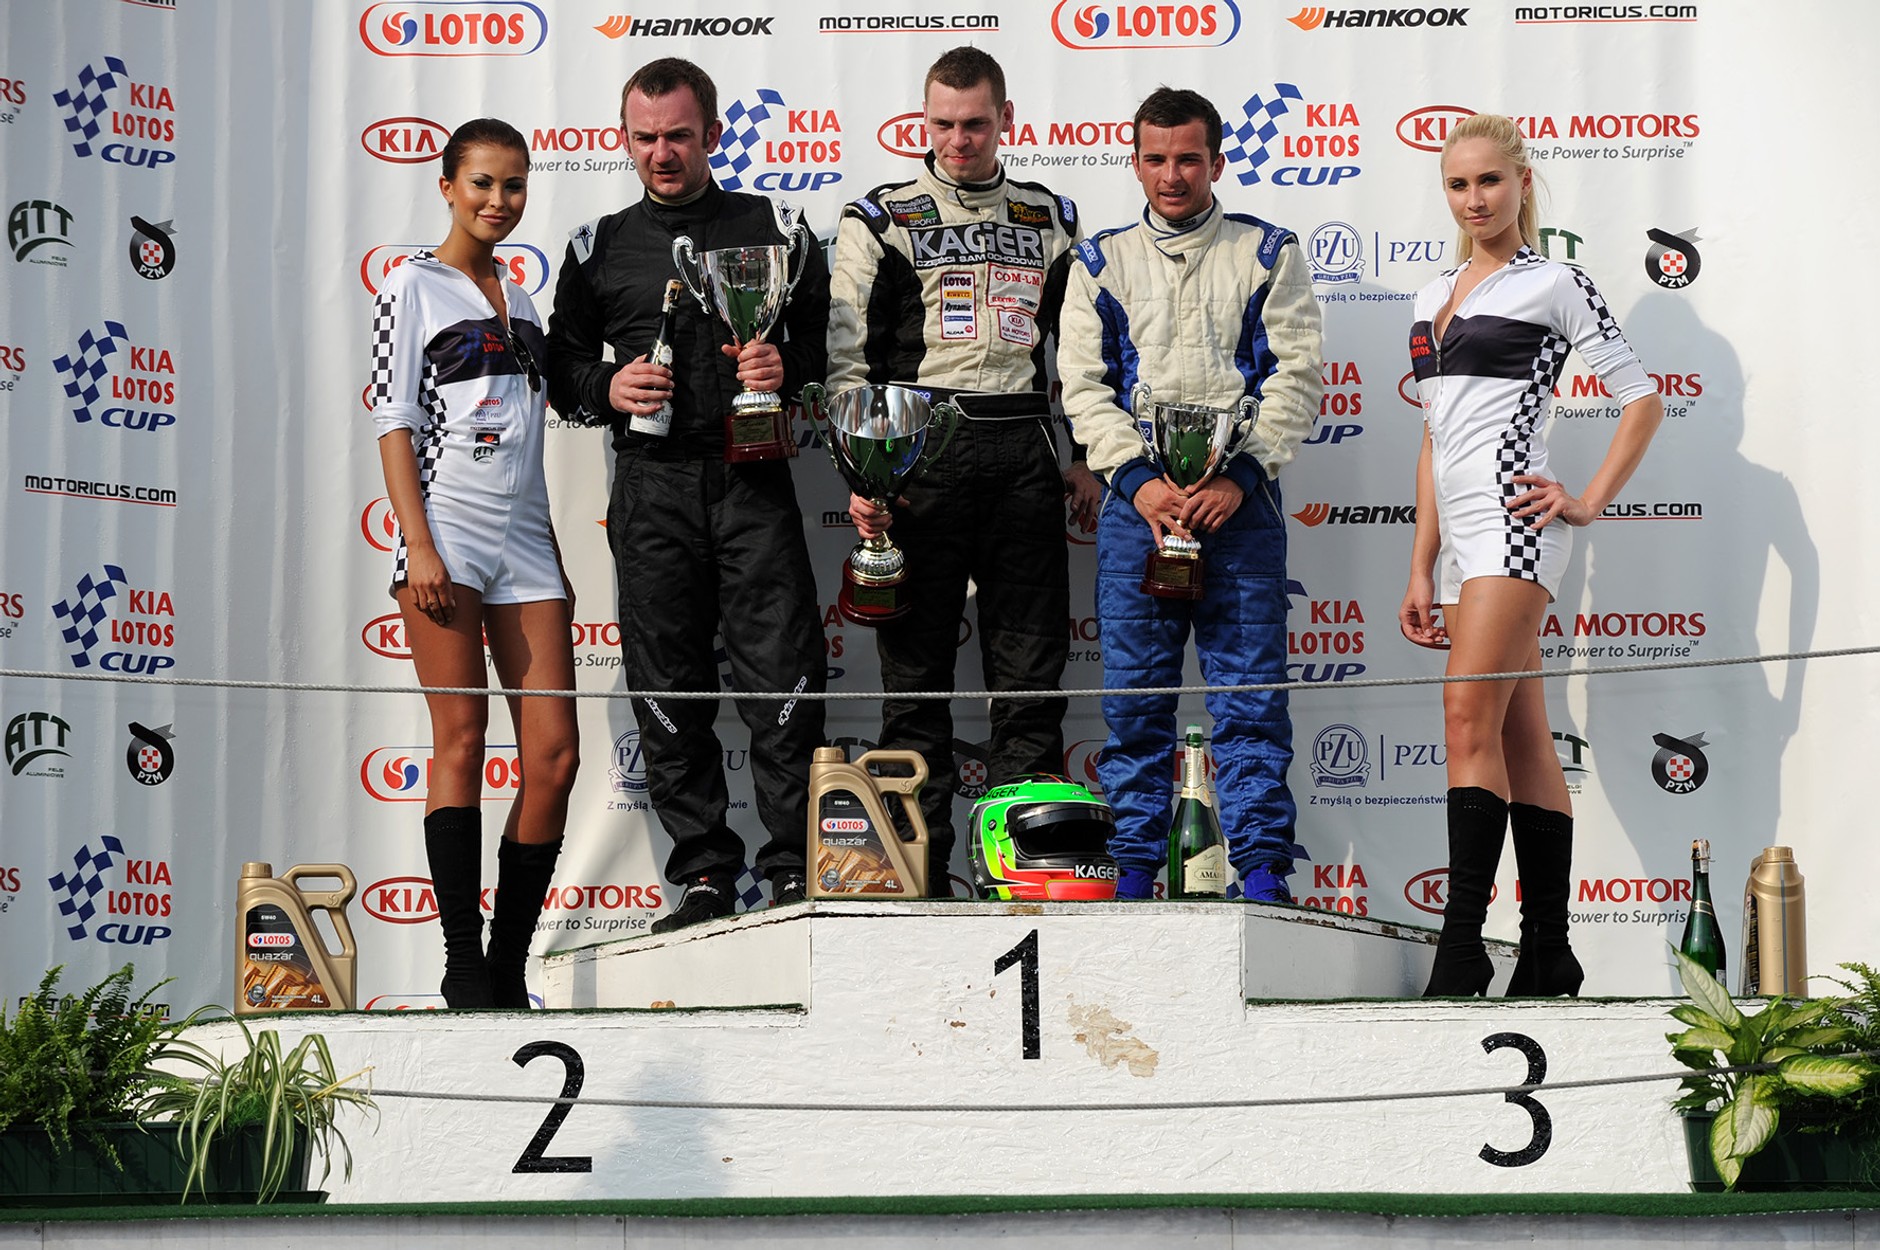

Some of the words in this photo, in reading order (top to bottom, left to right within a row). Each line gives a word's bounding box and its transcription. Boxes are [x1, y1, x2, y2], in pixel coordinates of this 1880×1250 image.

[425, 13, 525, 45] LOTOS
[1117, 5, 1217, 37] LOTOS
[131, 82, 175, 112] KIA
[113, 111, 174, 142] LOTOS
[788, 109, 842, 133] KIA
[1306, 104, 1360, 127] KIA
[1569, 114, 1700, 139] MOTORS
[379, 130, 437, 152] KIA
[532, 127, 622, 151] MOTO
[895, 124, 926, 147] KI
[1048, 121, 1134, 146] MOTO
[101, 143, 176, 169] CUP
[765, 140, 841, 164] LOTOS
[1284, 134, 1360, 158] LOTOS
[1552, 146, 1600, 160] Power
[1603, 146, 1618, 159] to
[1622, 145, 1685, 161] Surprise
[528, 160, 561, 171] ower
[565, 159, 580, 171] to
[583, 158, 636, 174] Surpris
[1002, 154, 1028, 166] The
[1031, 153, 1079, 166] Power
[1082, 154, 1098, 166] to
[1101, 152, 1133, 168] Surp
[753, 172, 843, 191] CUP
[1271, 166, 1361, 186] CUP
[8, 200, 74, 251] ATT
[910, 223, 1042, 259] KAGER
[1389, 241, 1445, 263] PZU
[139, 264, 165, 278] PZM
[944, 277, 971, 286] LOTOS
[1658, 273, 1689, 288] PZM
[1360, 291, 1418, 303] bezpieczeń
[131, 346, 175, 374] KIA
[112, 375, 174, 405] LOTOS
[1320, 393, 1362, 416] TOS
[1554, 406, 1601, 419] Power
[1605, 406, 1620, 418] to
[101, 408, 176, 431] CUP
[1302, 425, 1364, 444] UP
[1599, 503, 1702, 517] CUS.COM
[129, 589, 175, 616] KIA
[1311, 600, 1365, 624] KIA
[111, 619, 174, 648] LOTOS
[379, 624, 410, 648] KI
[571, 622, 622, 647] OTO
[1574, 612, 1706, 637] MOTORS
[1288, 631, 1365, 654] LOTOS
[1557, 645, 1605, 659] Power
[1608, 645, 1624, 657] to
[1627, 643, 1690, 660] Surprise
[99, 652, 175, 675] CUP
[586, 654, 623, 669] Surp
[1286, 663, 1366, 682] CUP
[5, 712, 71, 766] ATT
[1394, 744, 1447, 766] PZU
[138, 769, 163, 784] PZM
[1665, 780, 1697, 794] PZM
[617, 799, 648, 812] myślą
[1310, 796, 1317, 804] Z
[1320, 794, 1352, 807] myślą
[1355, 797, 1362, 805] o
[837, 821, 864, 830] LOTOS
[823, 838, 867, 847] quazar
[126, 860, 172, 886] KIA
[885, 880, 897, 889] 4L
[1075, 865, 1118, 881] KAGER
[1314, 864, 1368, 888] KIA
[379, 889, 438, 912] KIA
[1578, 878, 1692, 903] MOTOR
[108, 890, 171, 918] LOTOS
[565, 917, 581, 930] to
[583, 915, 647, 933] Surprise
[1612, 911, 1628, 923] to
[1632, 909, 1686, 926] Surpris
[96, 923, 172, 945] CUP
[264, 935, 290, 944] LOTOS
[249, 953, 294, 962] quazar
[311, 994, 324, 1003] 4L
[994, 929, 1040, 1060] 1
[511, 1039, 593, 1173] 2
[1480, 1031, 1551, 1168] 3
